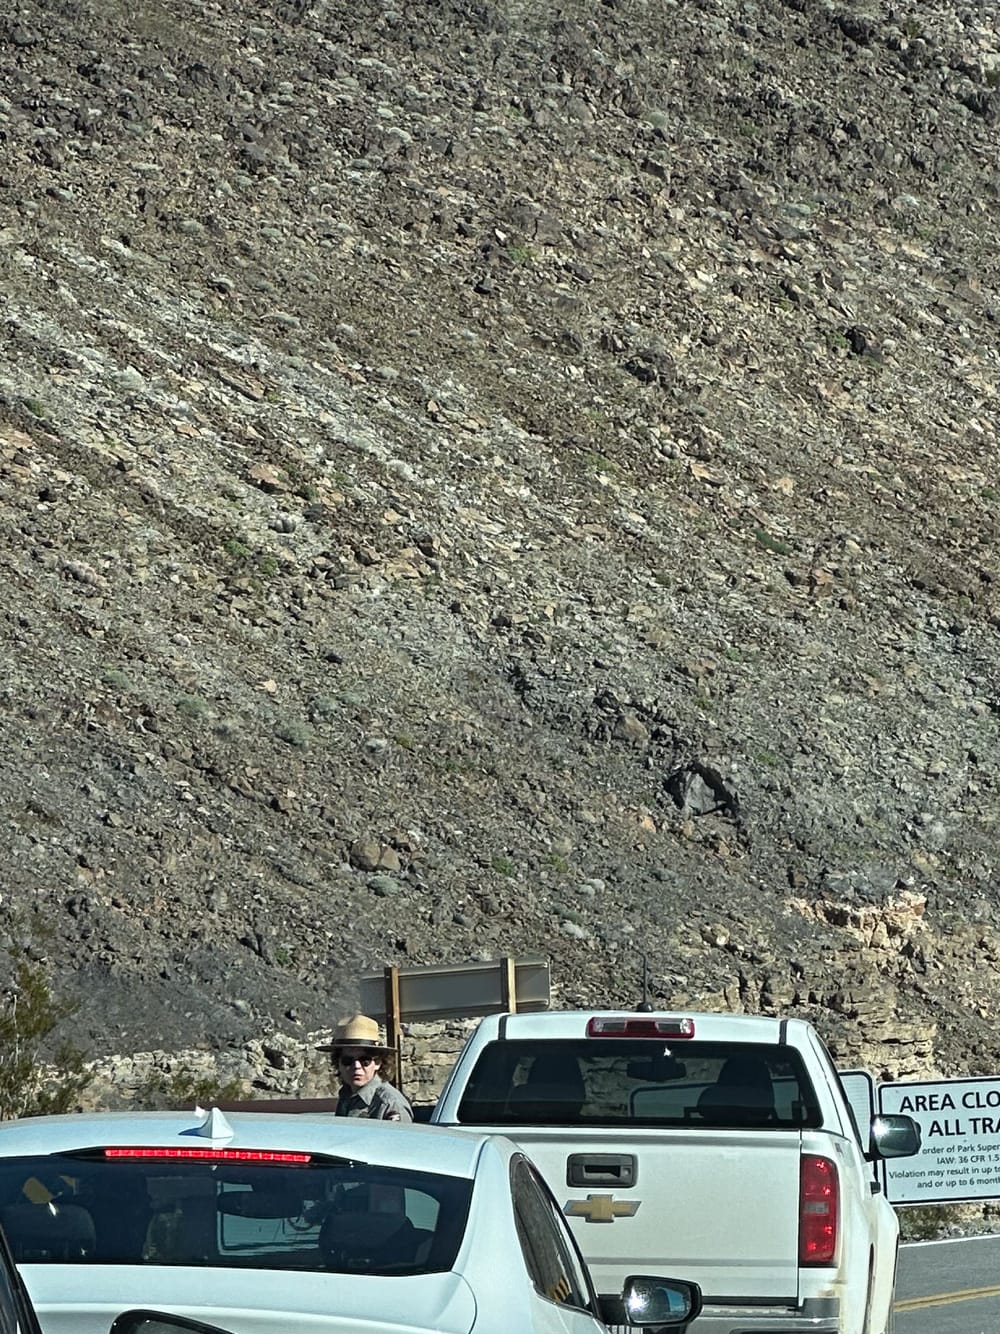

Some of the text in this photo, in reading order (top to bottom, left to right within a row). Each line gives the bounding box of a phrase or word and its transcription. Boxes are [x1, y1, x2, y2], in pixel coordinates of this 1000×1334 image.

[899, 1093, 956, 1113] AREA
[928, 1119, 966, 1137] ALL
[922, 1146, 944, 1155] order
[946, 1145, 955, 1153] of
[957, 1144, 975, 1152] Park
[958, 1156, 969, 1164] 36
[970, 1154, 986, 1163] CFR
[988, 1153, 1000, 1162] 1.5
[889, 1169, 926, 1179] Violation
[927, 1169, 945, 1177] may
[946, 1167, 969, 1175] result
[971, 1166, 980, 1174] in
[981, 1167, 992, 1175] up
[917, 1180, 933, 1188] and
[945, 1180, 957, 1188] up
[958, 1178, 968, 1186] to
[969, 1177, 975, 1186] 6
